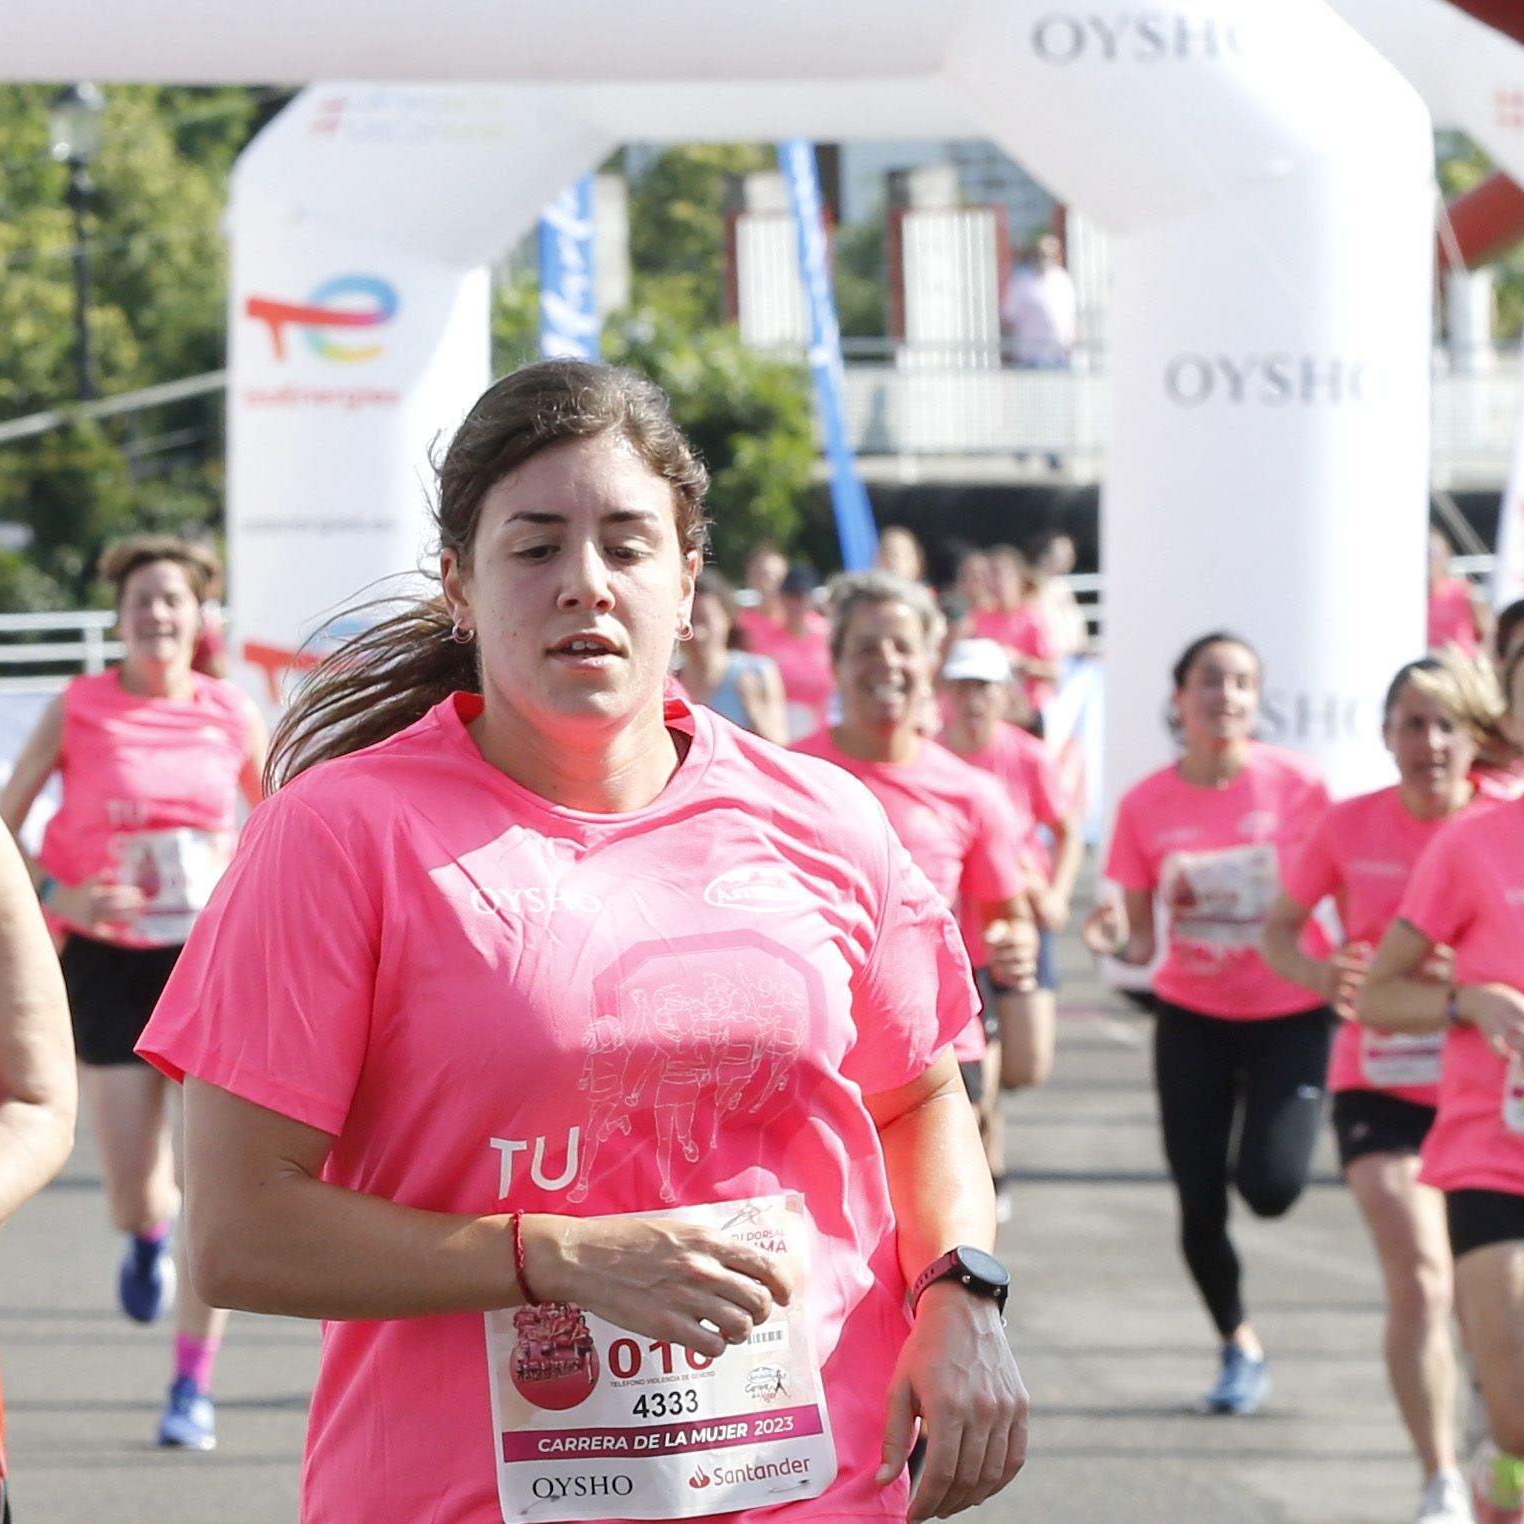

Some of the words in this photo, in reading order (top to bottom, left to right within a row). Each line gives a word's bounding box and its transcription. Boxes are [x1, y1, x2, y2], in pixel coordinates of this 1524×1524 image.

[489, 1126, 581, 1201] TU
[632, 1389, 699, 1419] 4333
[537, 1434, 628, 1453] CARRERA
[633, 1433, 660, 1450] DE
[664, 1430, 688, 1447] LA
[691, 1421, 748, 1445] MUJER
[754, 1415, 794, 1437] 2023
[714, 1457, 811, 1486] Santander
[532, 1475, 633, 1499] OYSHO
